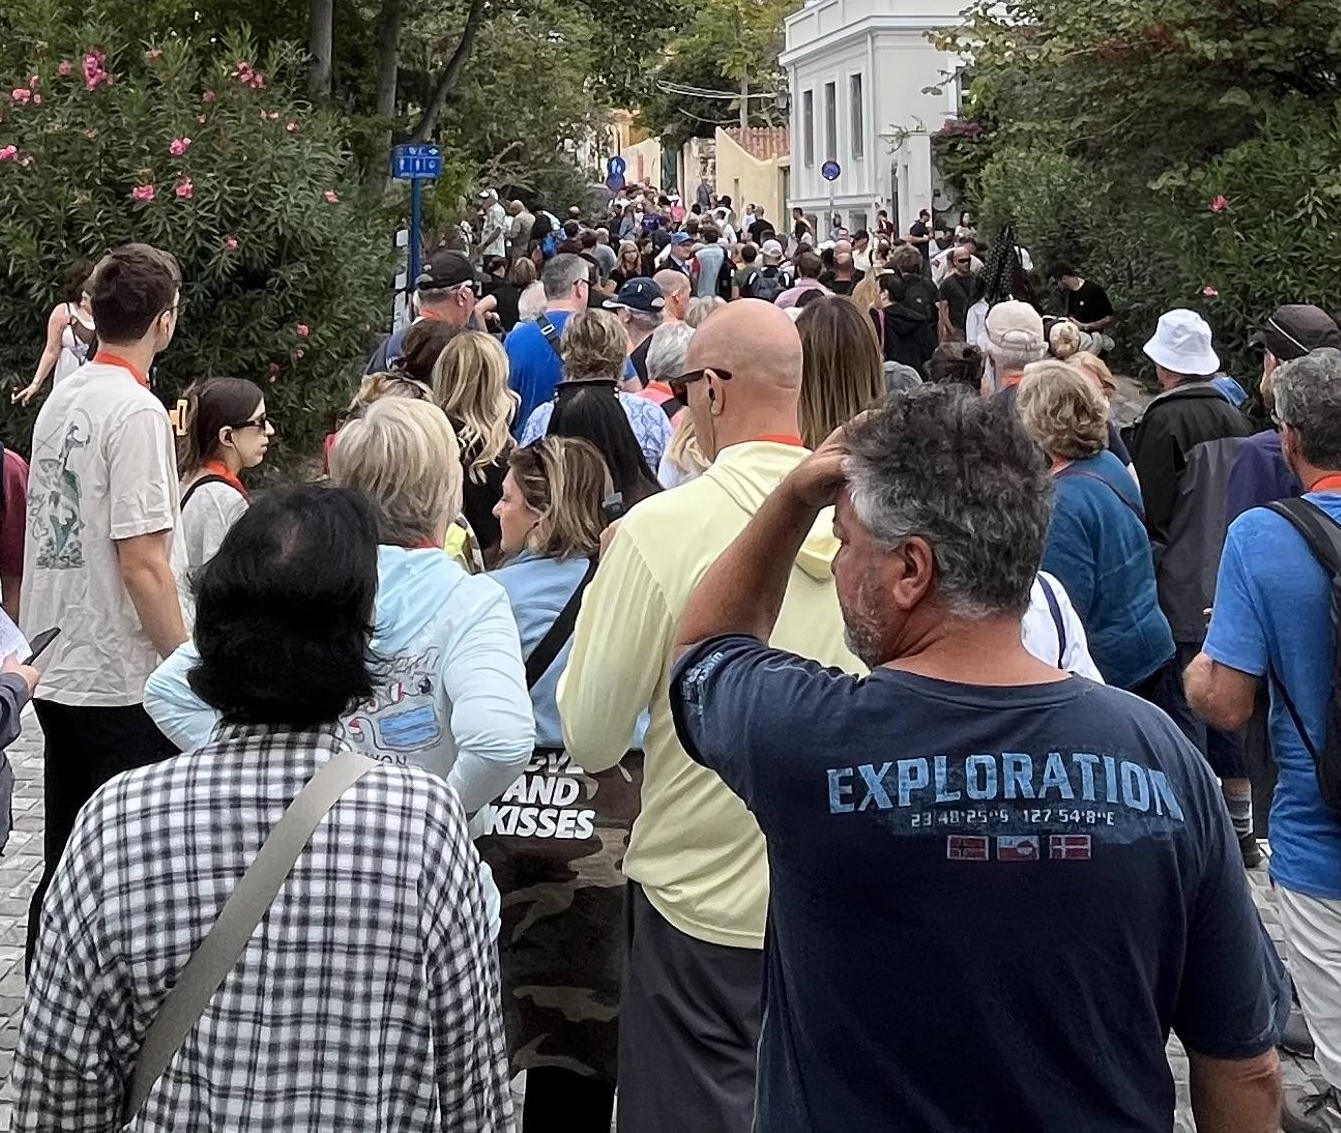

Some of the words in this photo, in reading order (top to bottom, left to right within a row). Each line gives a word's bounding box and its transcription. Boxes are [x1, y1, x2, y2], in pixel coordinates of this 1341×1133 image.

[501, 774, 580, 806] AND
[826, 752, 1185, 822] EXPLORATION
[484, 805, 596, 840] KISSES
